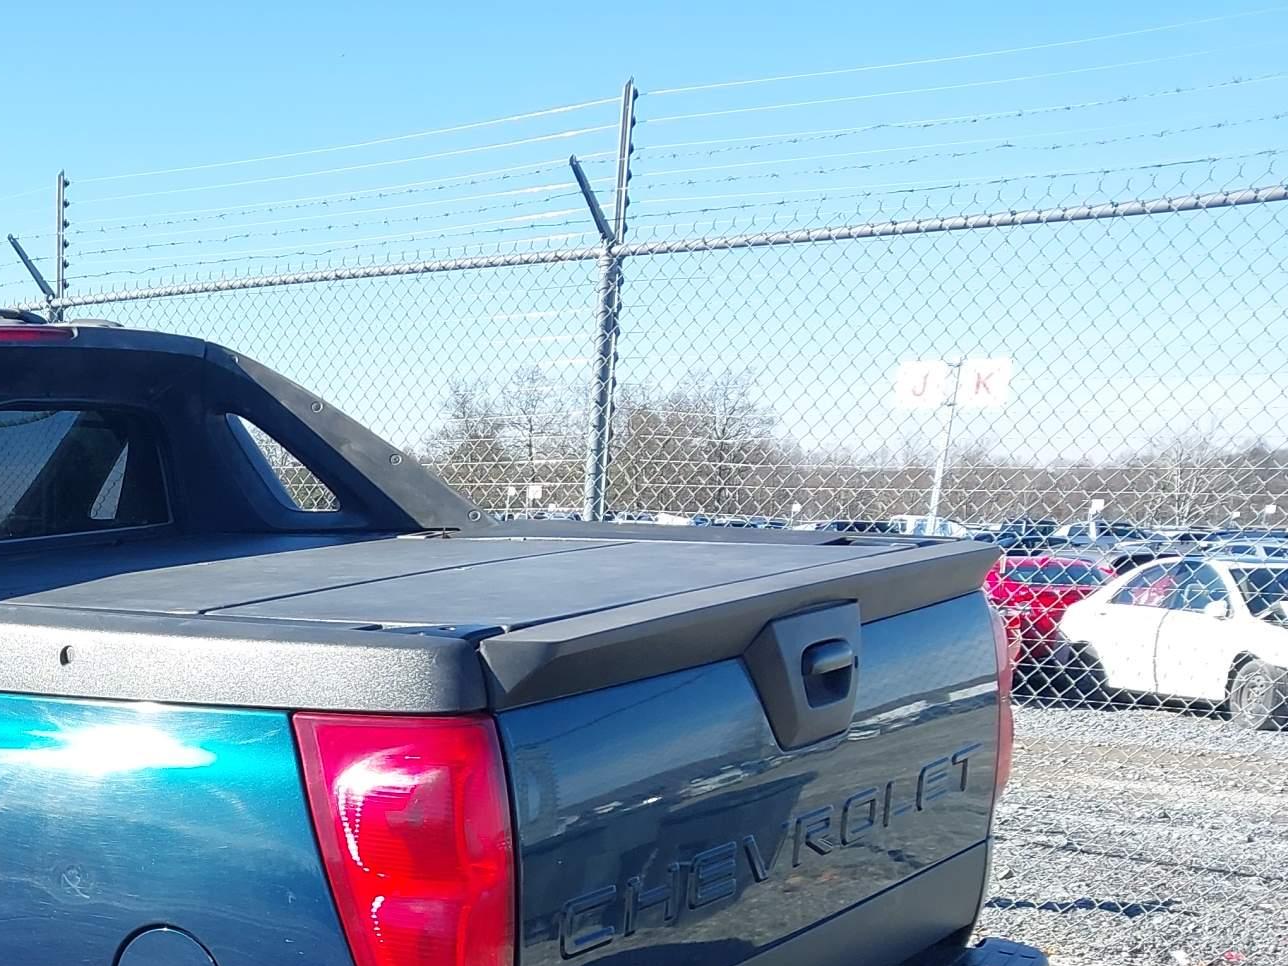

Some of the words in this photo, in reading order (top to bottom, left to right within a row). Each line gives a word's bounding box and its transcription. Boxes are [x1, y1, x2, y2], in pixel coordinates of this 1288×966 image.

[912, 370, 930, 397] J
[975, 372, 995, 395] K
[559, 743, 984, 961] CHEVROLET
